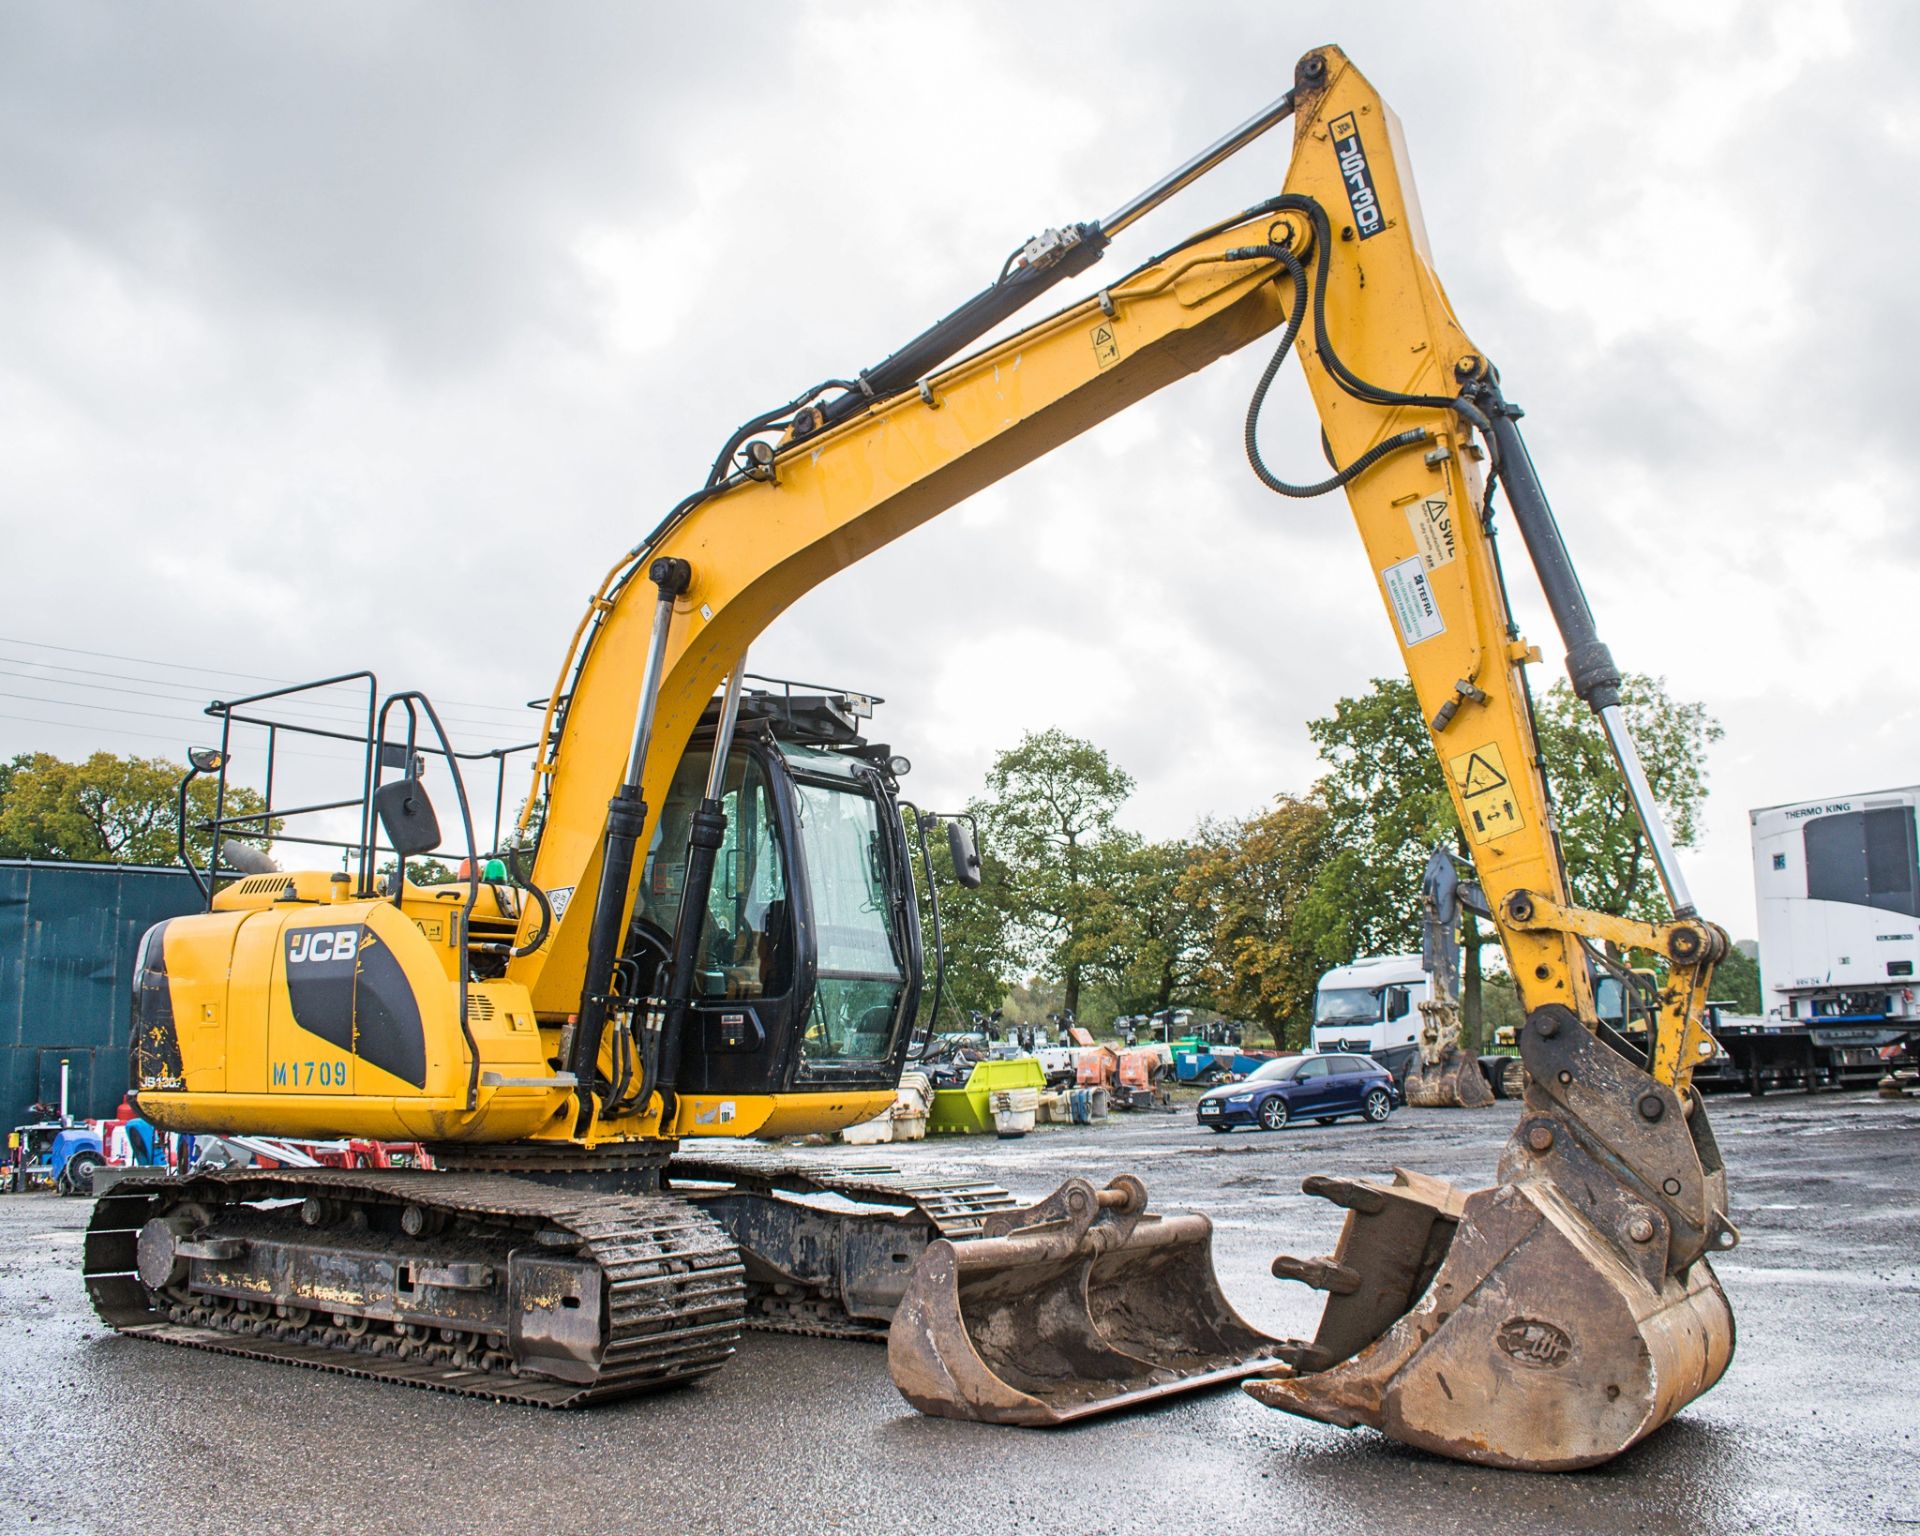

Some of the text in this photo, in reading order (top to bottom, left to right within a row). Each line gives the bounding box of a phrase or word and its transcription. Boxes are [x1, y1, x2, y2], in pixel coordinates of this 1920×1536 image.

[1339, 137, 1380, 234] JS130 LC
[1438, 518, 1455, 558] SWL
[1417, 585, 1433, 617] TEFRA
[1785, 803, 1851, 820] THERMO KING
[290, 930, 358, 963] JCB
[273, 1061, 347, 1087] M1709
